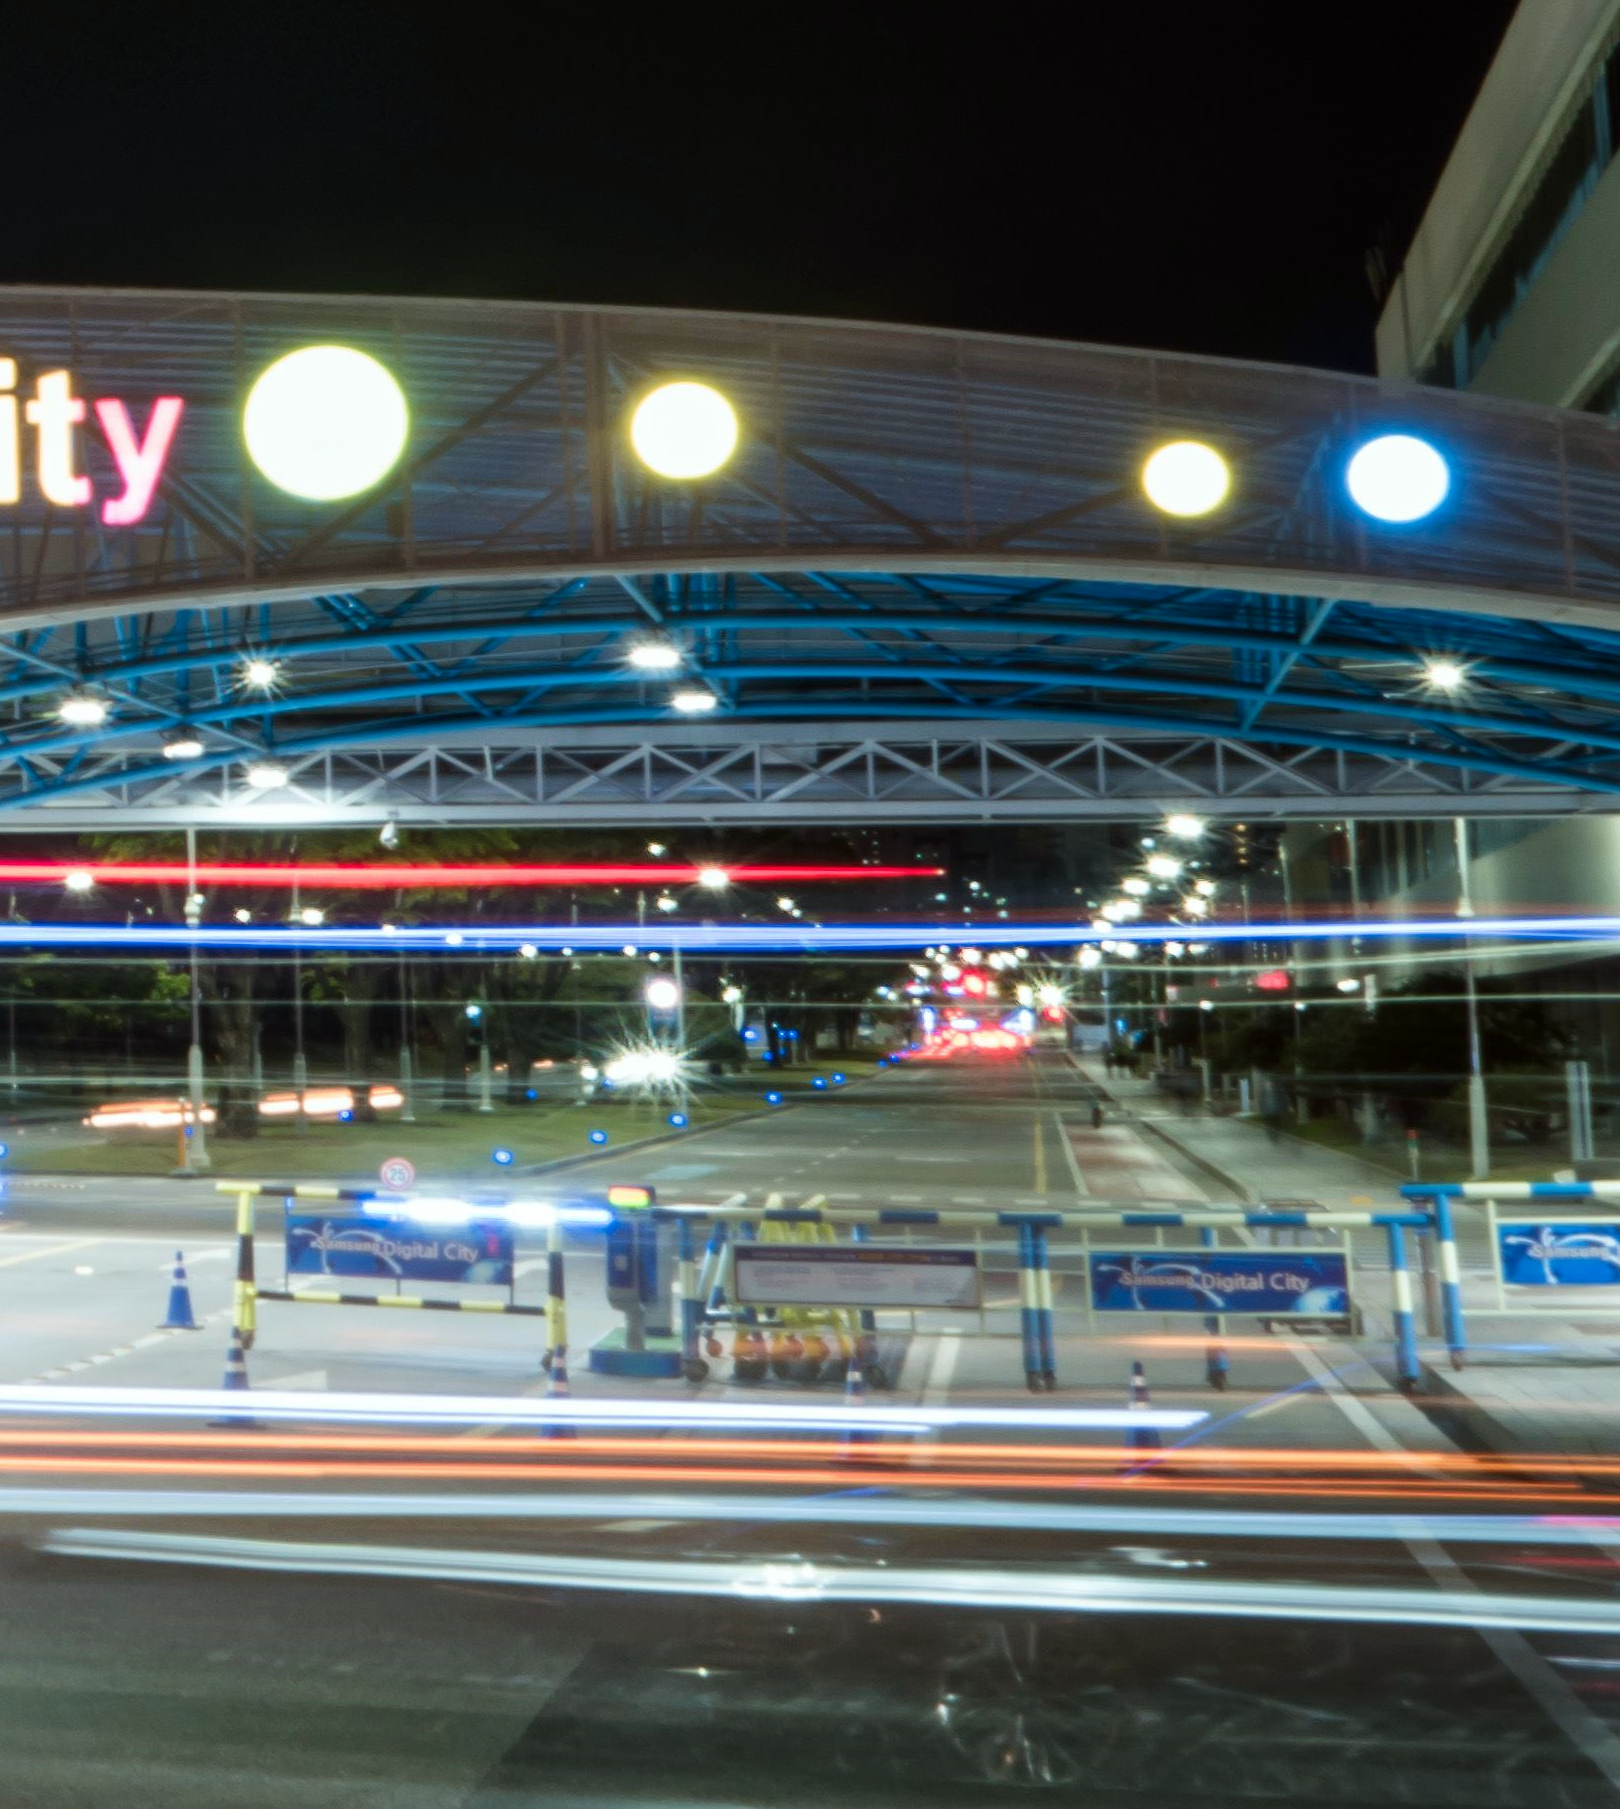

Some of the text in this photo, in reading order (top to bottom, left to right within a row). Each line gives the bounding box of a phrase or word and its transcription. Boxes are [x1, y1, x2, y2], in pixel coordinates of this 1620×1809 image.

[383, 1242, 439, 1260] Digital
[444, 1243, 479, 1263] City
[1201, 1272, 1263, 1292] Digital
[1270, 1273, 1310, 1293] City
